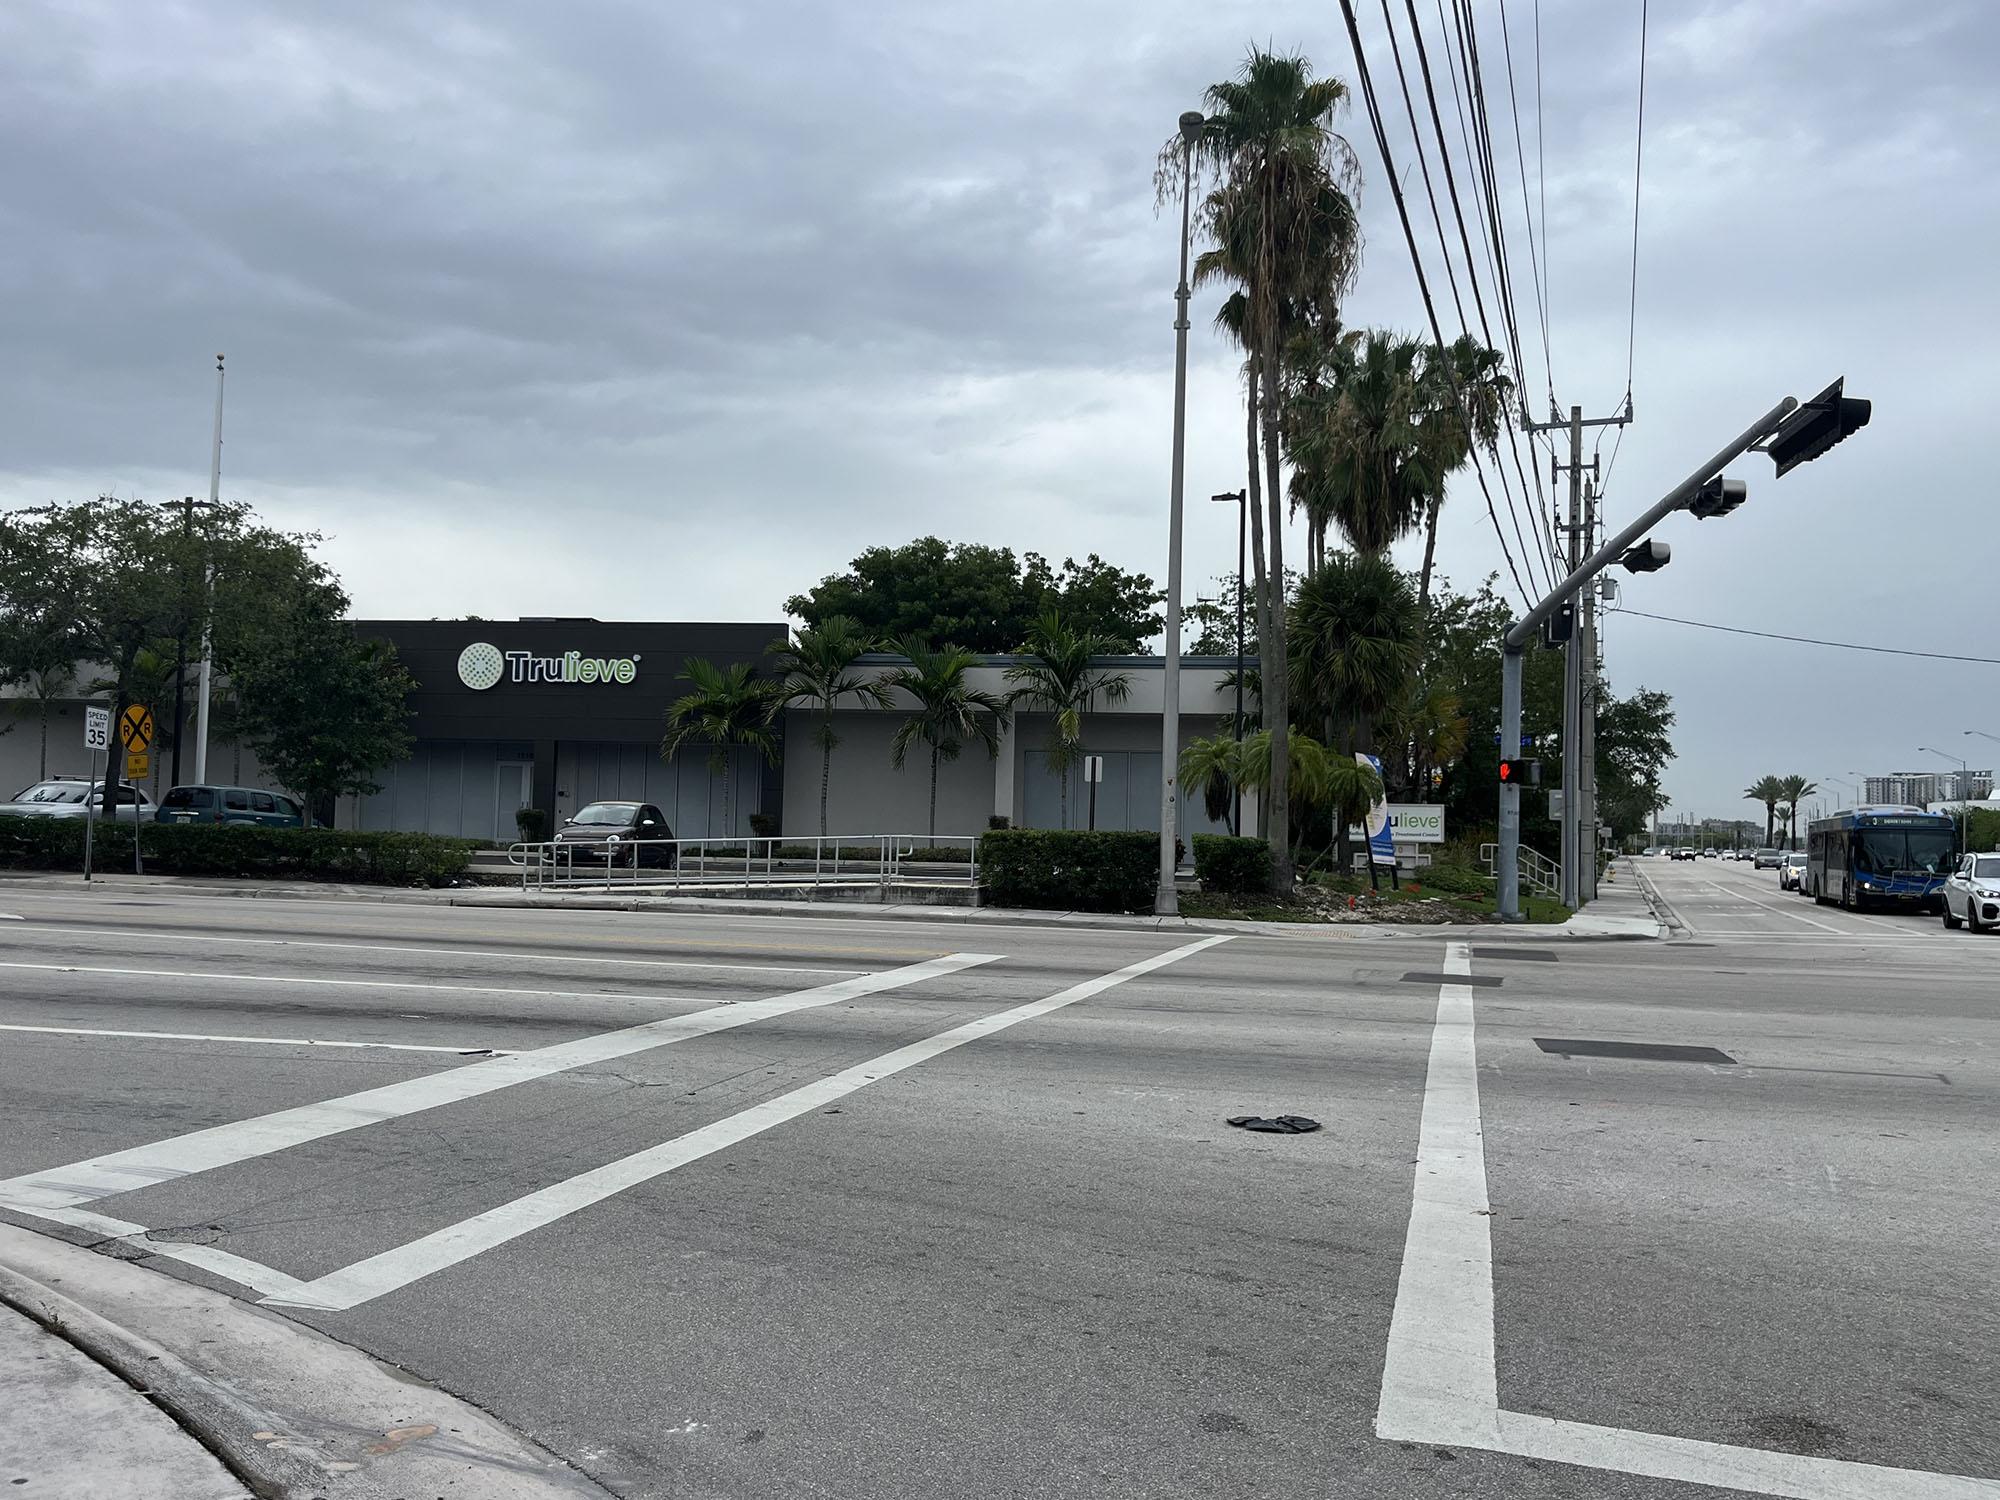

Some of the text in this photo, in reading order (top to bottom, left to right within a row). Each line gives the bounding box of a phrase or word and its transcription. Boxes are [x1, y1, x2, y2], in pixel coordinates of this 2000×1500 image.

[506, 650, 636, 683] Trulieve
[88, 711, 108, 721] SPEED
[89, 720, 105, 729] LIMIT
[88, 729, 105, 746] 35
[1389, 812, 1439, 828] ulieve
